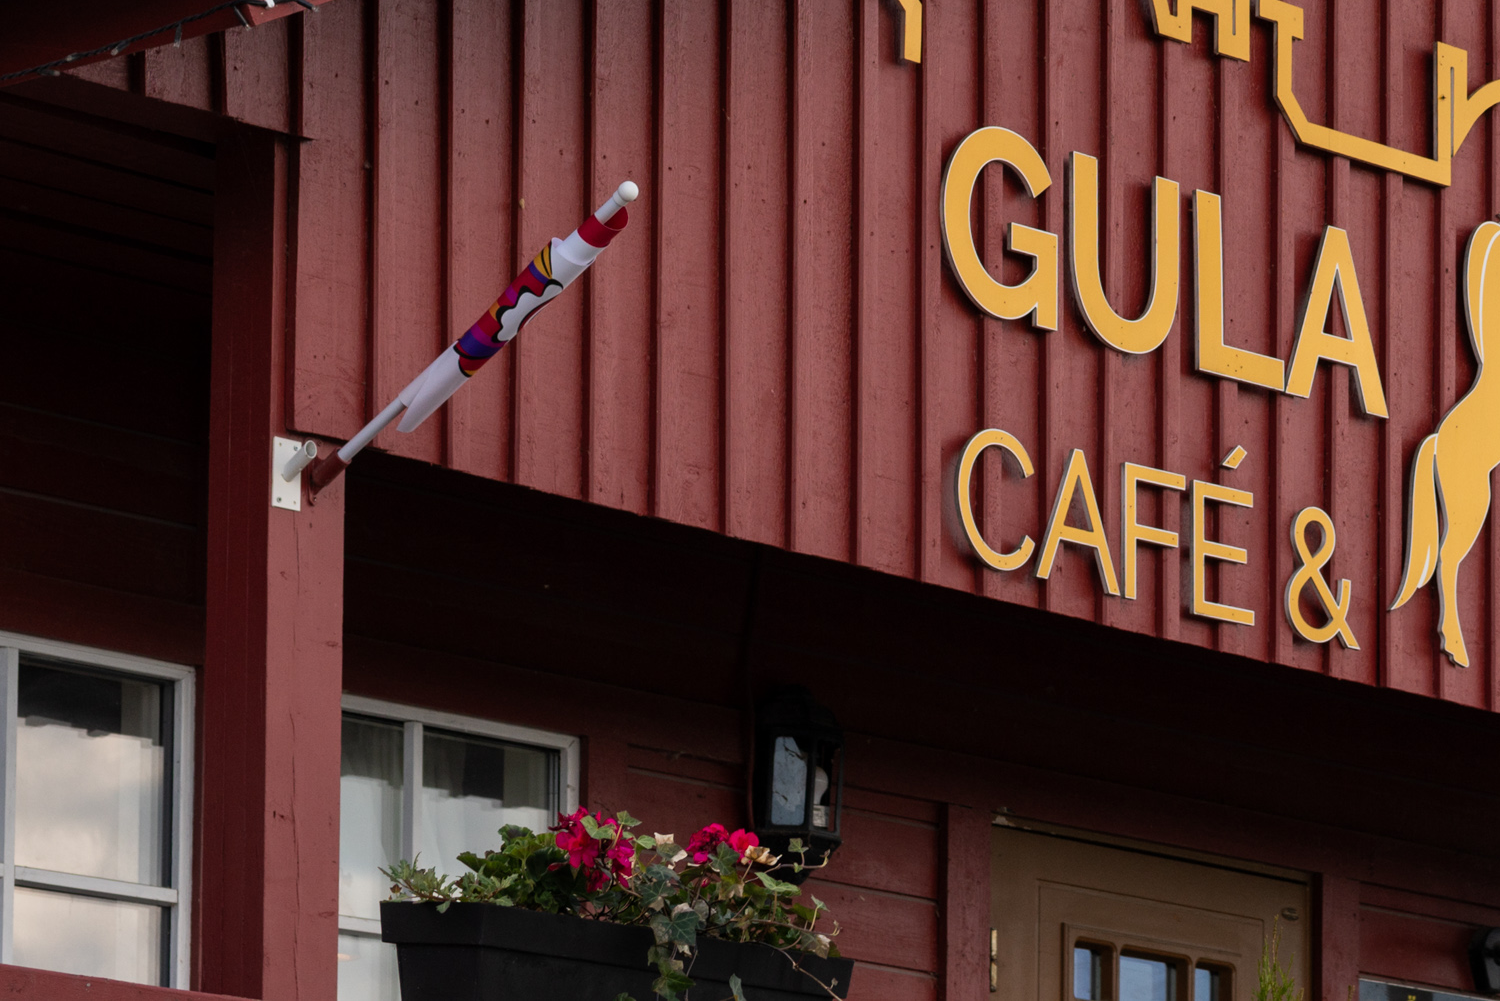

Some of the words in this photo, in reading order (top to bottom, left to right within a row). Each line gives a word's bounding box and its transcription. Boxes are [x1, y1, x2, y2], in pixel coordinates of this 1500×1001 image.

[941, 126, 1389, 419] GULA
[956, 428, 1255, 626] CAFÉ
[1285, 506, 1360, 650] &
